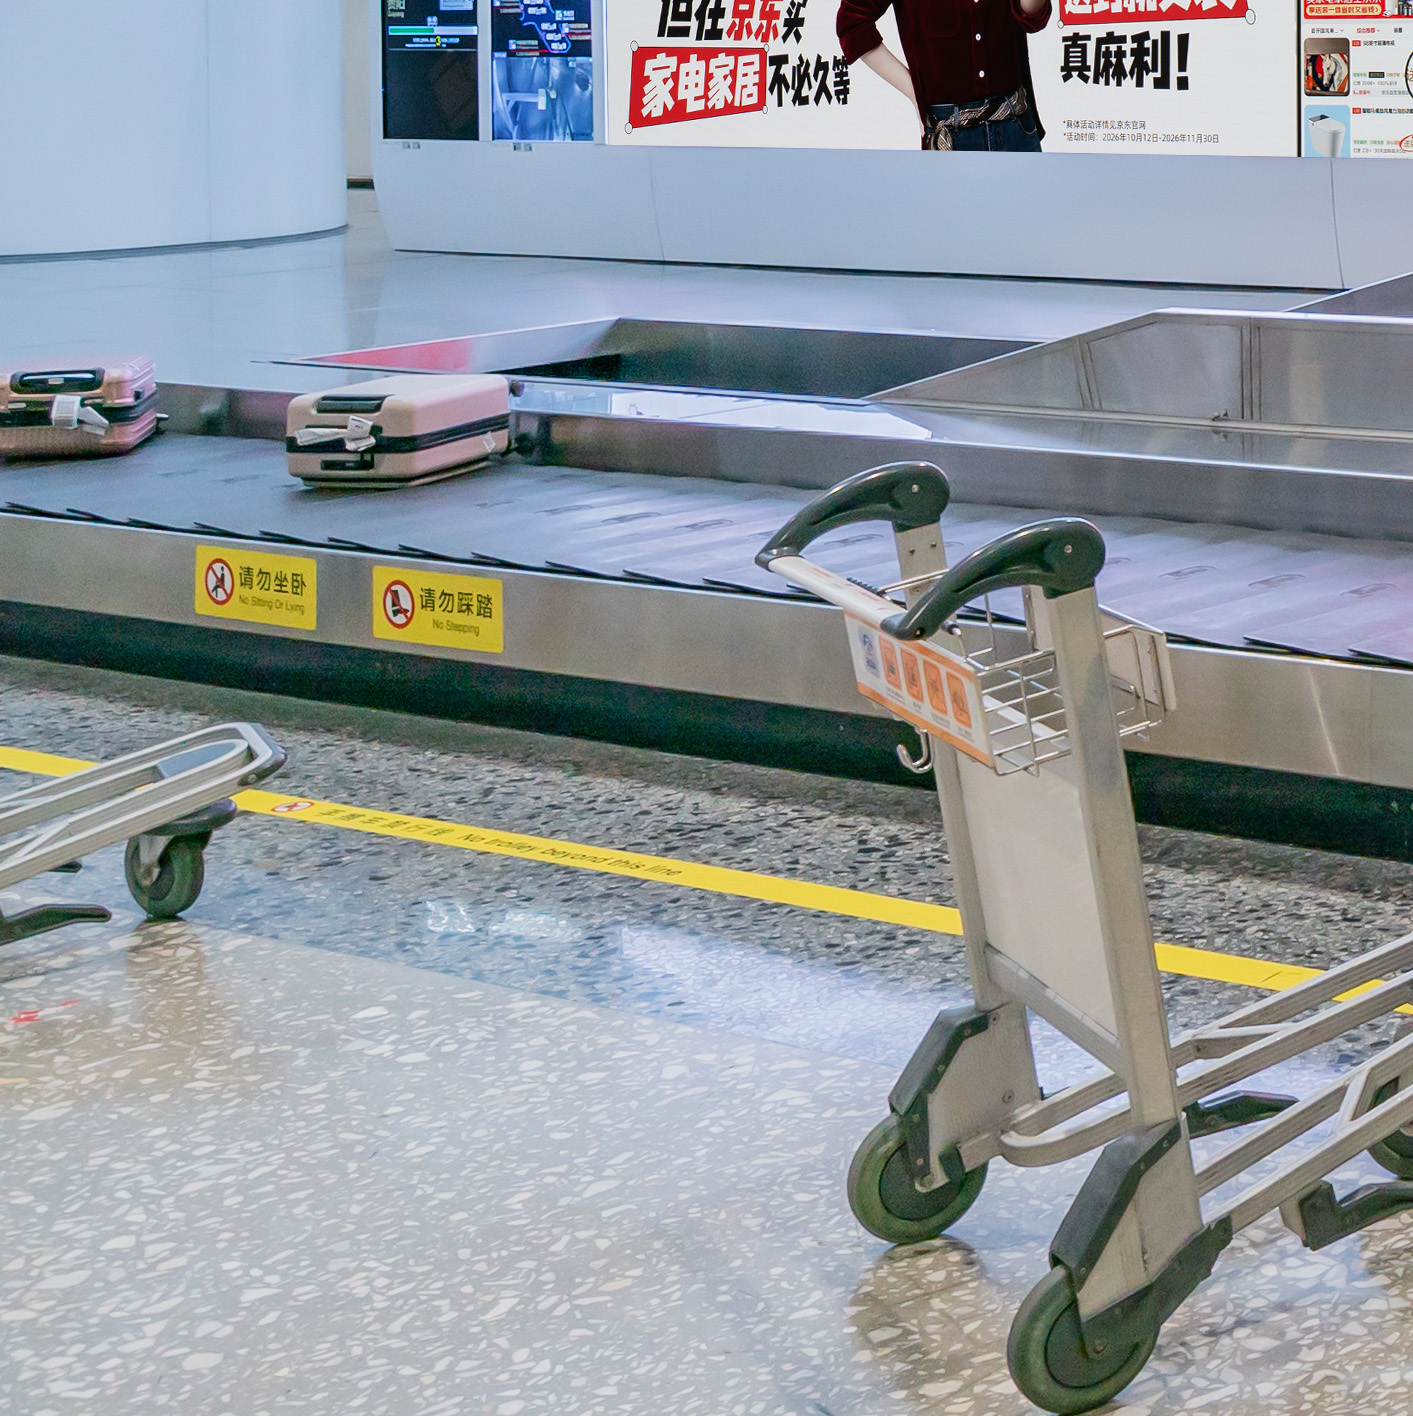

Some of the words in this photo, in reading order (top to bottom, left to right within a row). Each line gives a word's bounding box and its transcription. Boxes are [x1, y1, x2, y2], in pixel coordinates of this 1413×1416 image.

[1060, 30, 1190, 91] 真麻利!
[239, 565, 306, 597] 请勿坐卧
[239, 594, 249, 605] No
[274, 599, 284, 609] Or
[285, 601, 305, 615] Lying
[420, 587, 493, 619] 请勿踩踏
[433, 619, 444, 630] No
[446, 620, 480, 637] Stepping
[457, 832, 485, 843] No
[484, 836, 540, 853] trolley
[539, 847, 613, 865] beyond
[613, 859, 650, 871] this
[645, 864, 683, 877] line
